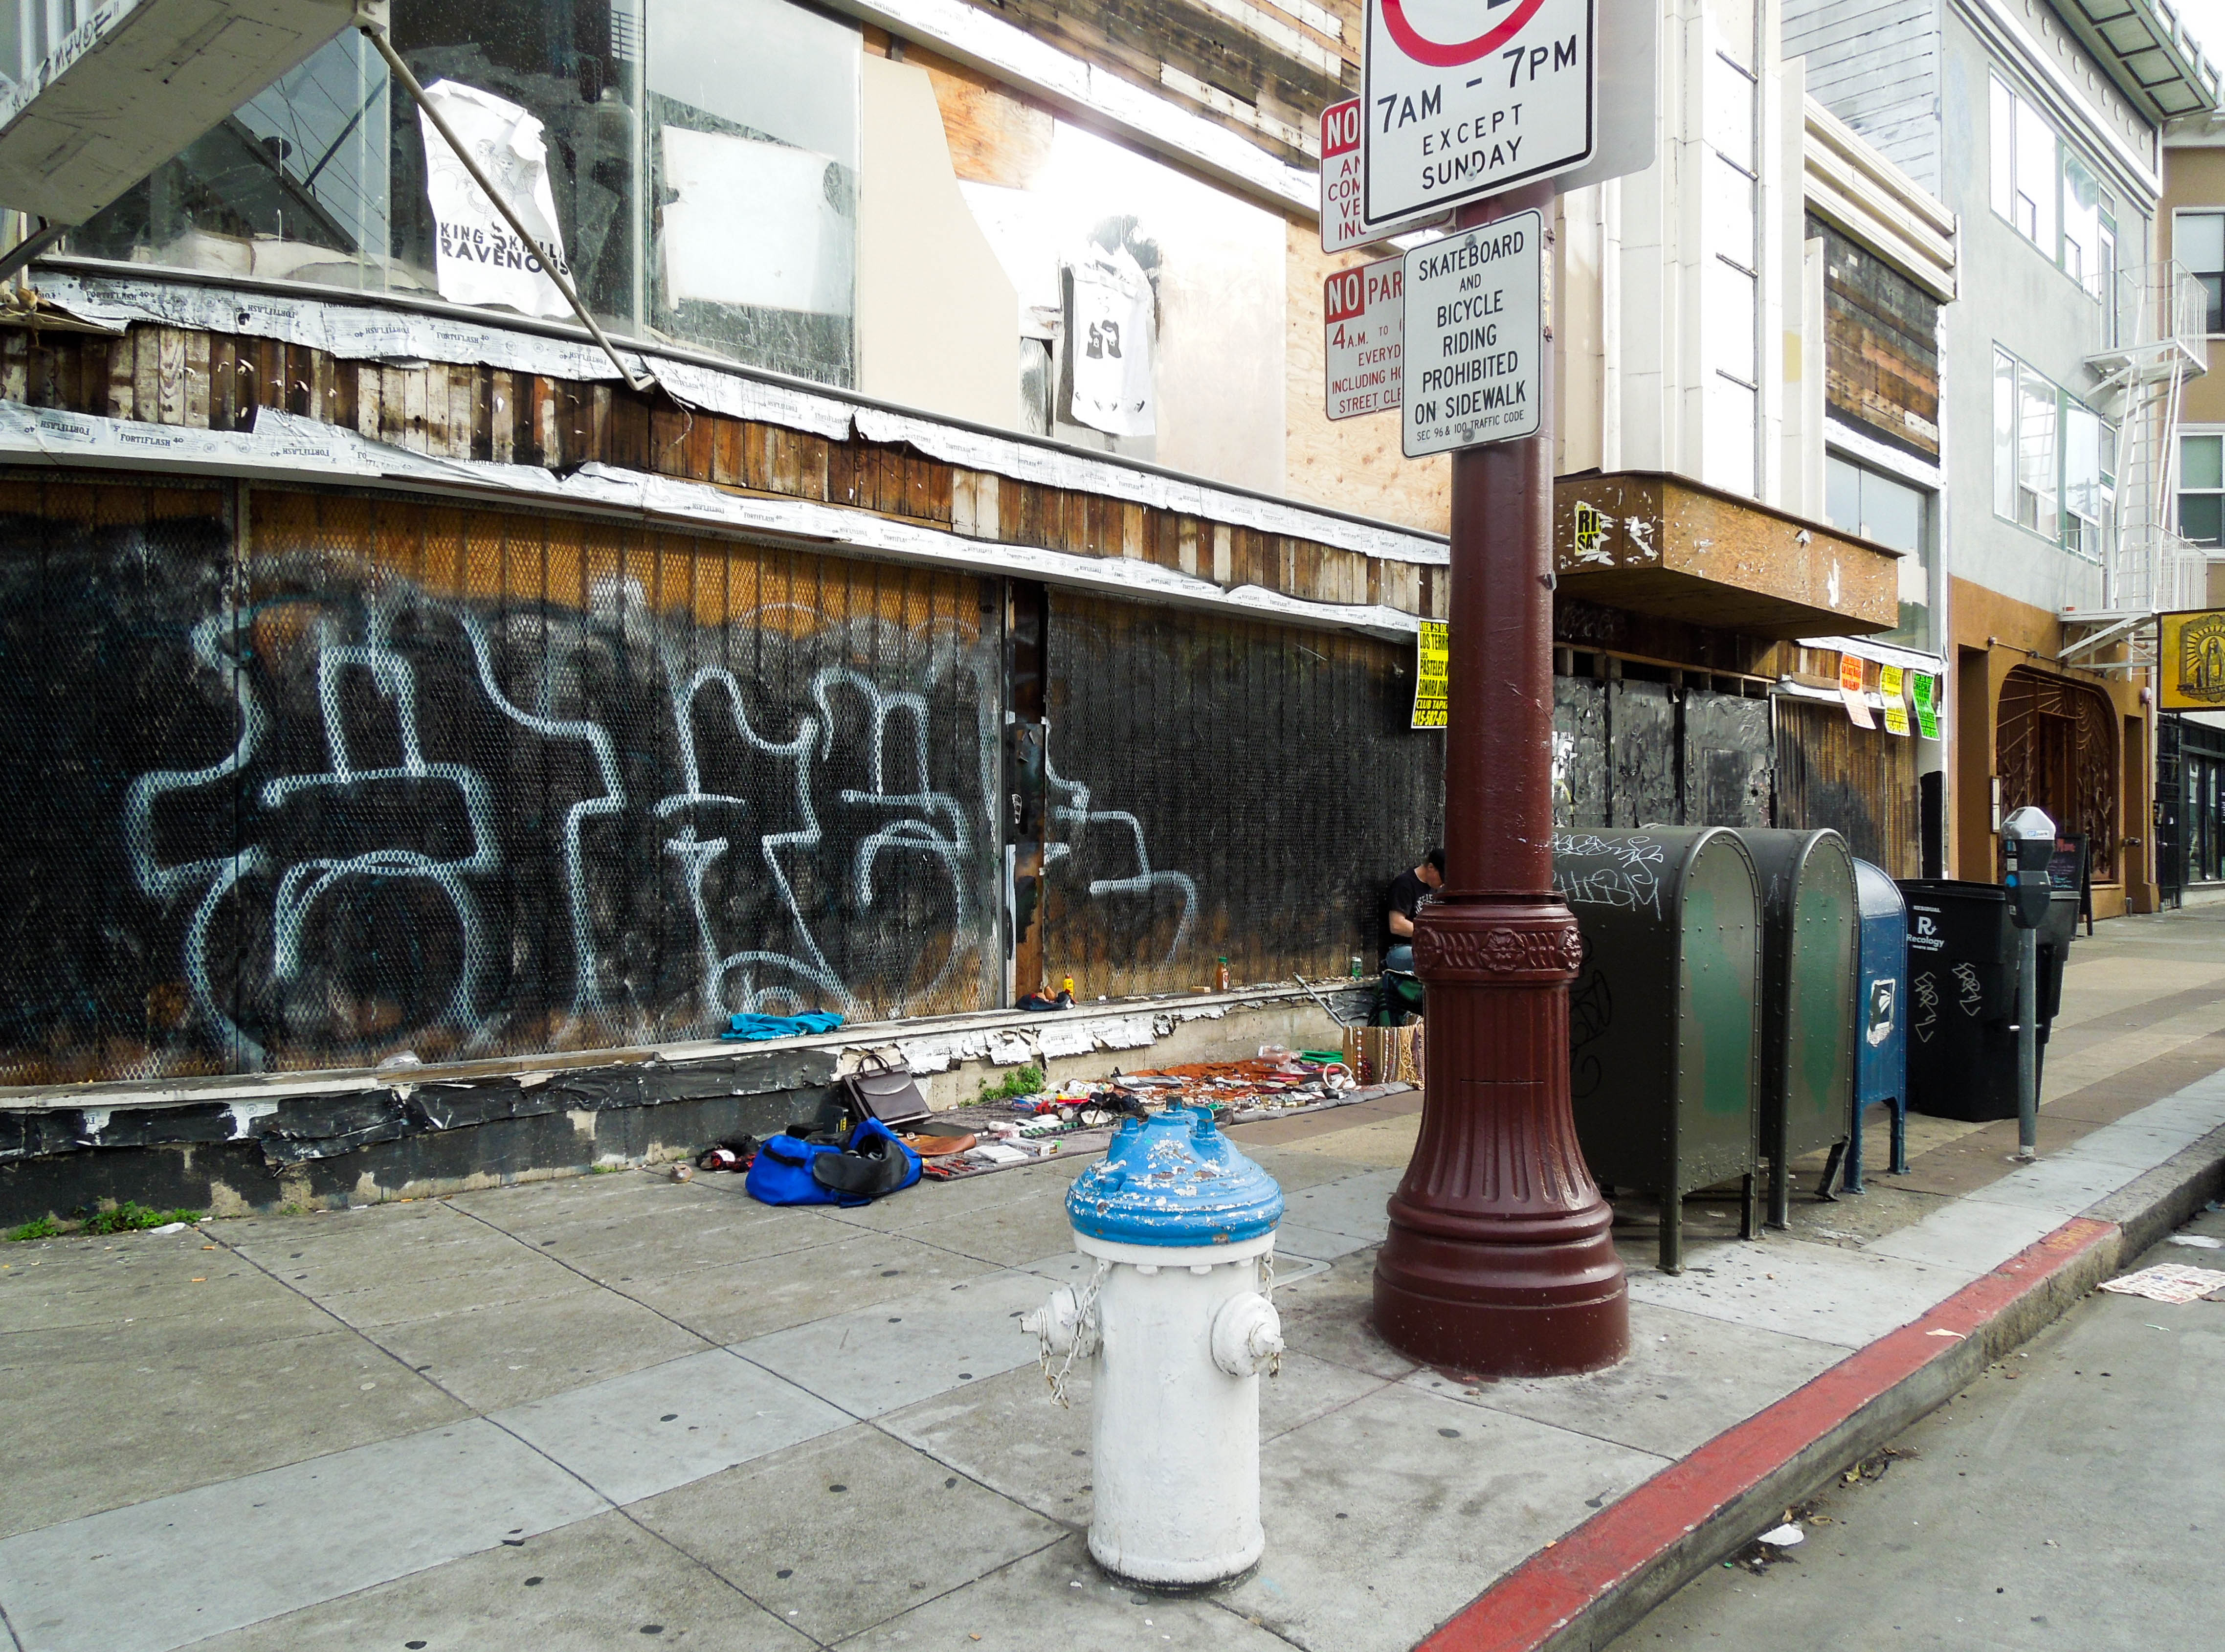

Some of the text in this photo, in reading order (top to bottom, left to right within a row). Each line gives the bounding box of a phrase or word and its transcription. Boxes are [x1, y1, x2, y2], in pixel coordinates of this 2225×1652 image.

[1378, 84, 1441, 133] 7AM
[1503, 34, 1576, 89] 7PM
[1328, 107, 1358, 149] NO
[1423, 103, 1522, 156] EXCEPT
[1340, 156, 1360, 178] AN
[1422, 135, 1522, 190] SUNDAY
[1340, 198, 1360, 218] VE
[441, 222, 484, 244] KING
[1419, 231, 1524, 281] SKATEBOARD
[1329, 270, 1402, 315] NO PAR
[1460, 273, 1481, 292] AND
[1437, 289, 1503, 328] BICYCLE
[1380, 325, 1388, 336] TO
[1443, 324, 1497, 357] RIDING
[1358, 344, 1401, 367] EVERYD
[1333, 369, 1385, 395] INCLUDING
[1423, 351, 1518, 393] PROHIBITED
[1339, 387, 1401, 414] STREET CLE
[1415, 380, 1526, 425] ON SIDEWALK
[41, 420, 90, 436] FORTIFLASH
[1417, 409, 1524, 441] SEC 96 & 100 TRAFFIC CODE
[120, 433, 171, 446] FORTIFLASH
[283, 447, 330, 456] FORTIFLASH
[1578, 510, 1602, 533] RI
[1420, 622, 1447, 632] VIER 29 DE
[1420, 632, 1430, 649] LOS
[1420, 660, 1444, 677] PASTELES
[1416, 699, 1431, 709] CLUB
[1907, 934, 1945, 948] Recology
